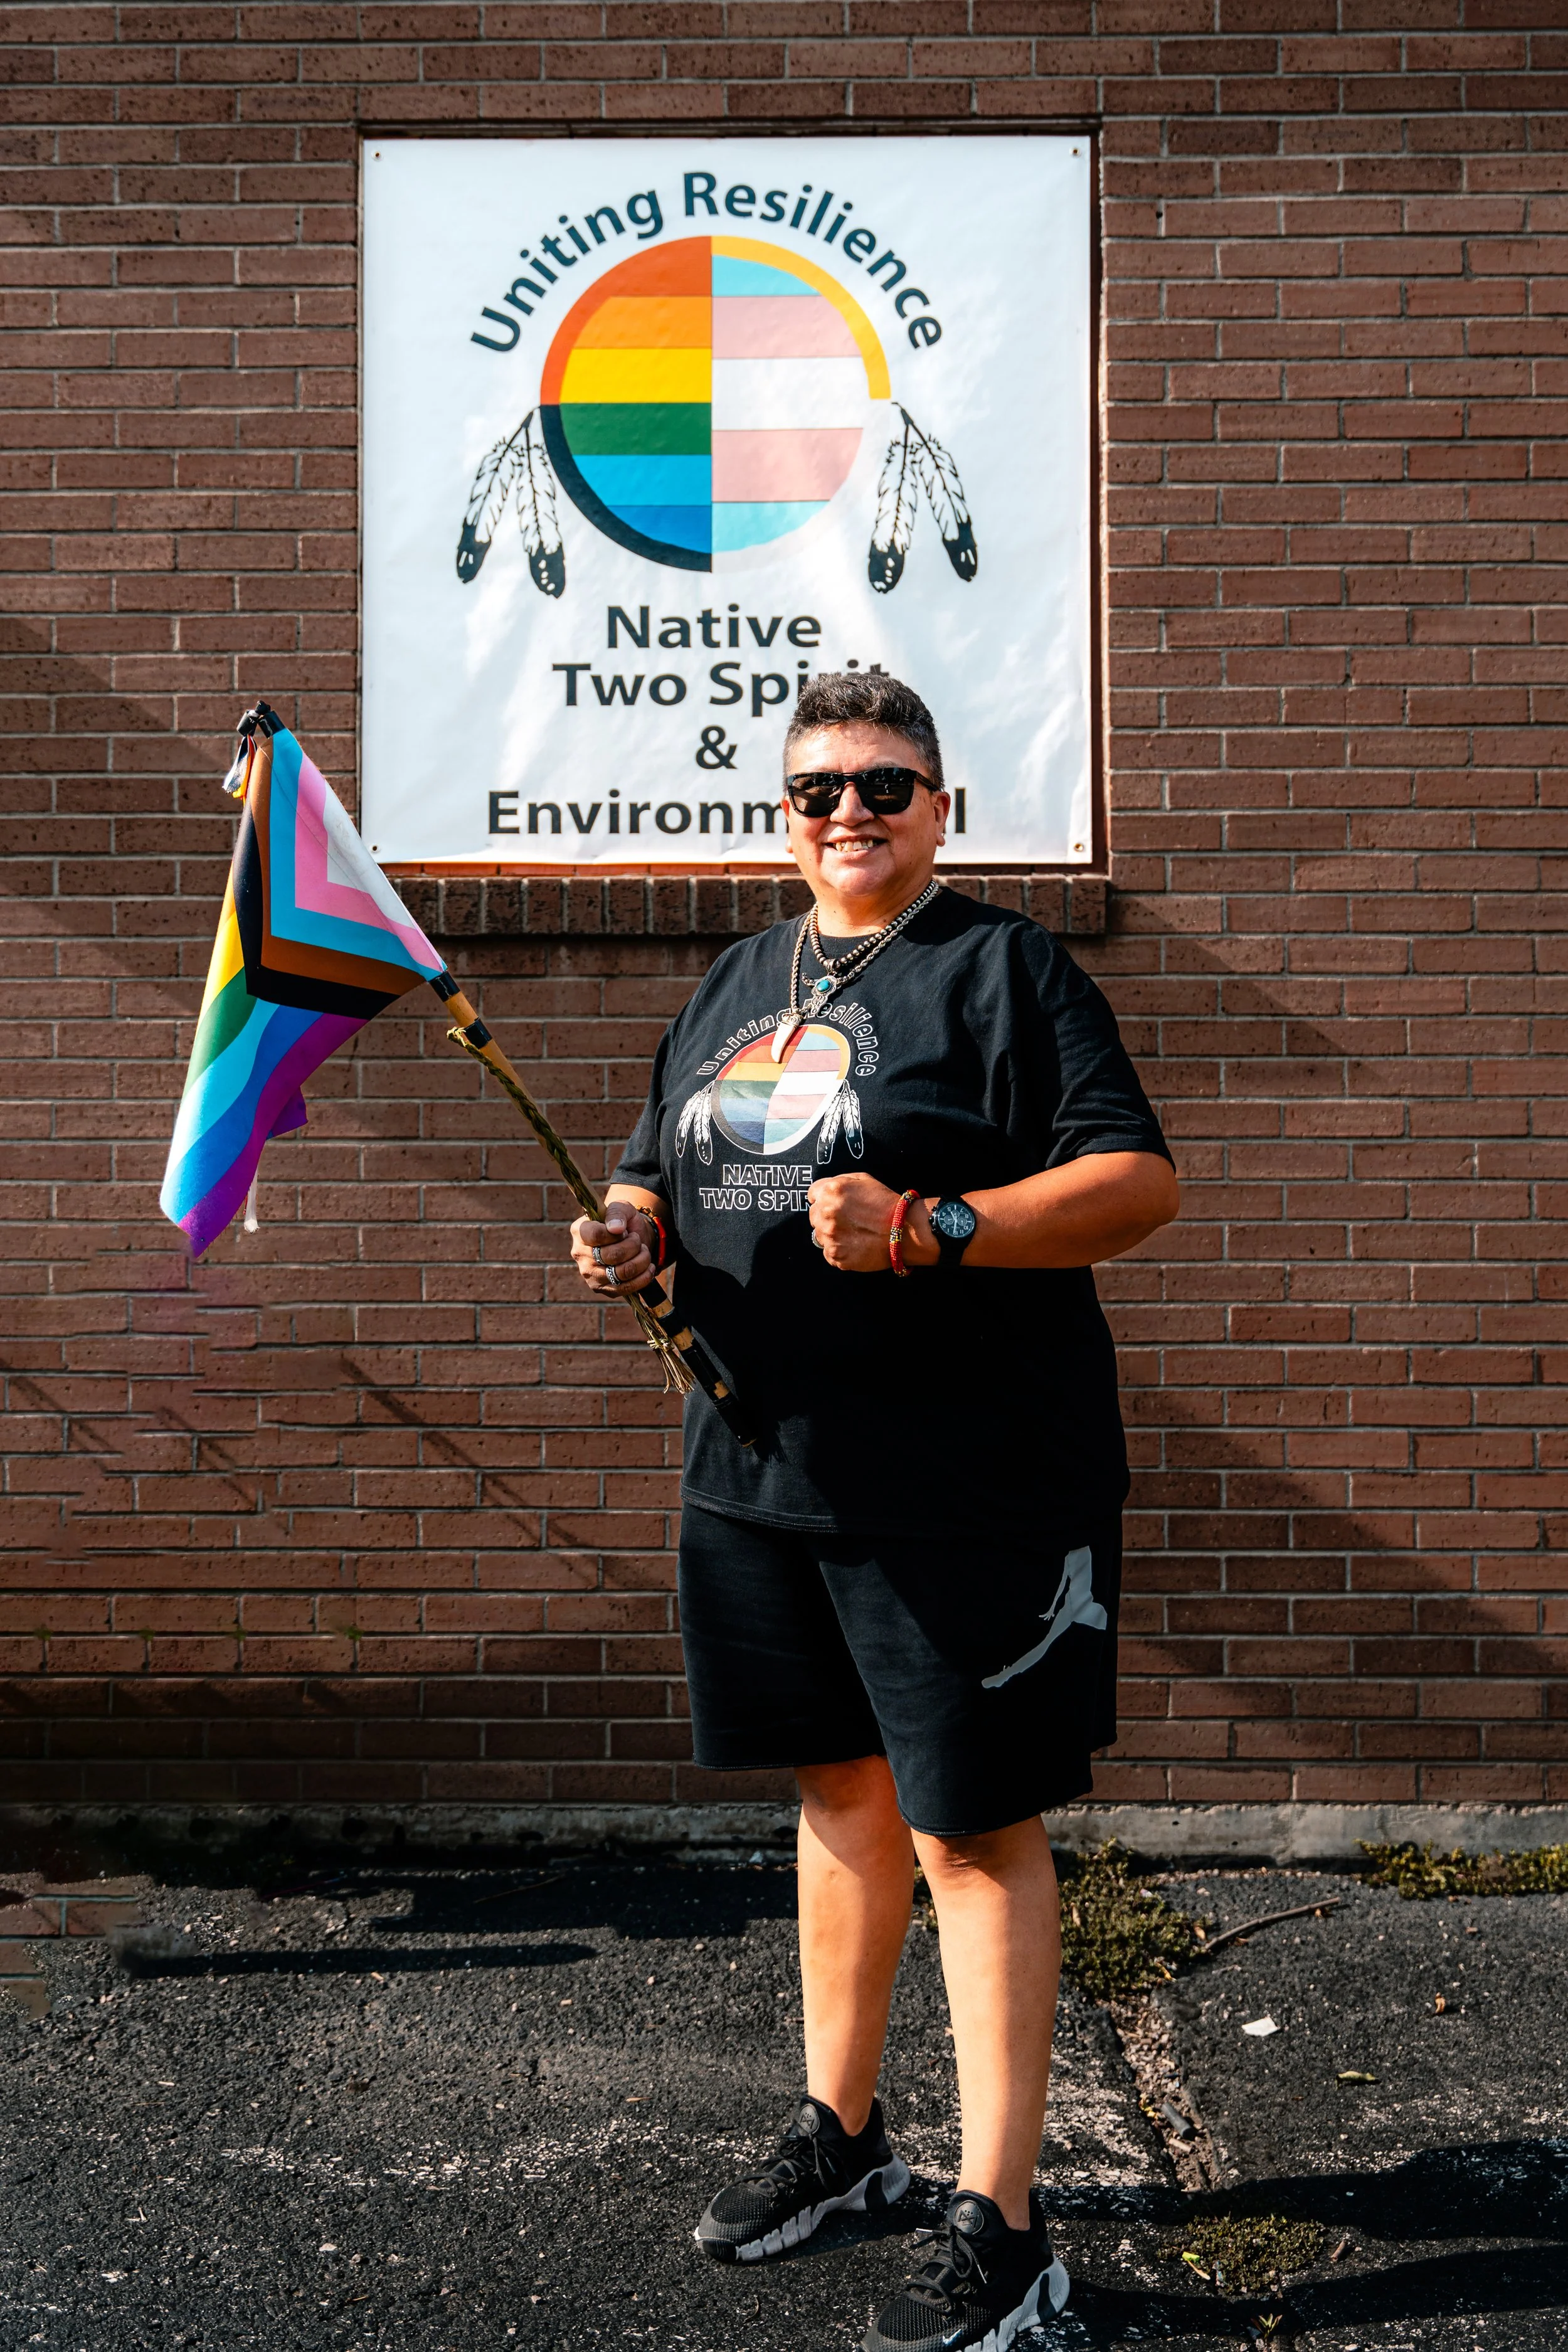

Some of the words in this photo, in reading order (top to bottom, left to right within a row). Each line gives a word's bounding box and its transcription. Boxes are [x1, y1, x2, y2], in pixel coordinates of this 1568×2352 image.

[470, 190, 664, 352] Uniting
[684, 172, 942, 349] Resilience
[607, 603, 822, 649] Native
[552, 663, 687, 706] Two
[709, 659, 890, 718] Spi
[695, 725, 738, 770] &
[488, 787, 966, 835] Environml
[723, 1164, 813, 1187] NATIVE
[699, 1188, 752, 1210] TWO
[758, 1189, 810, 1211] SPIR
